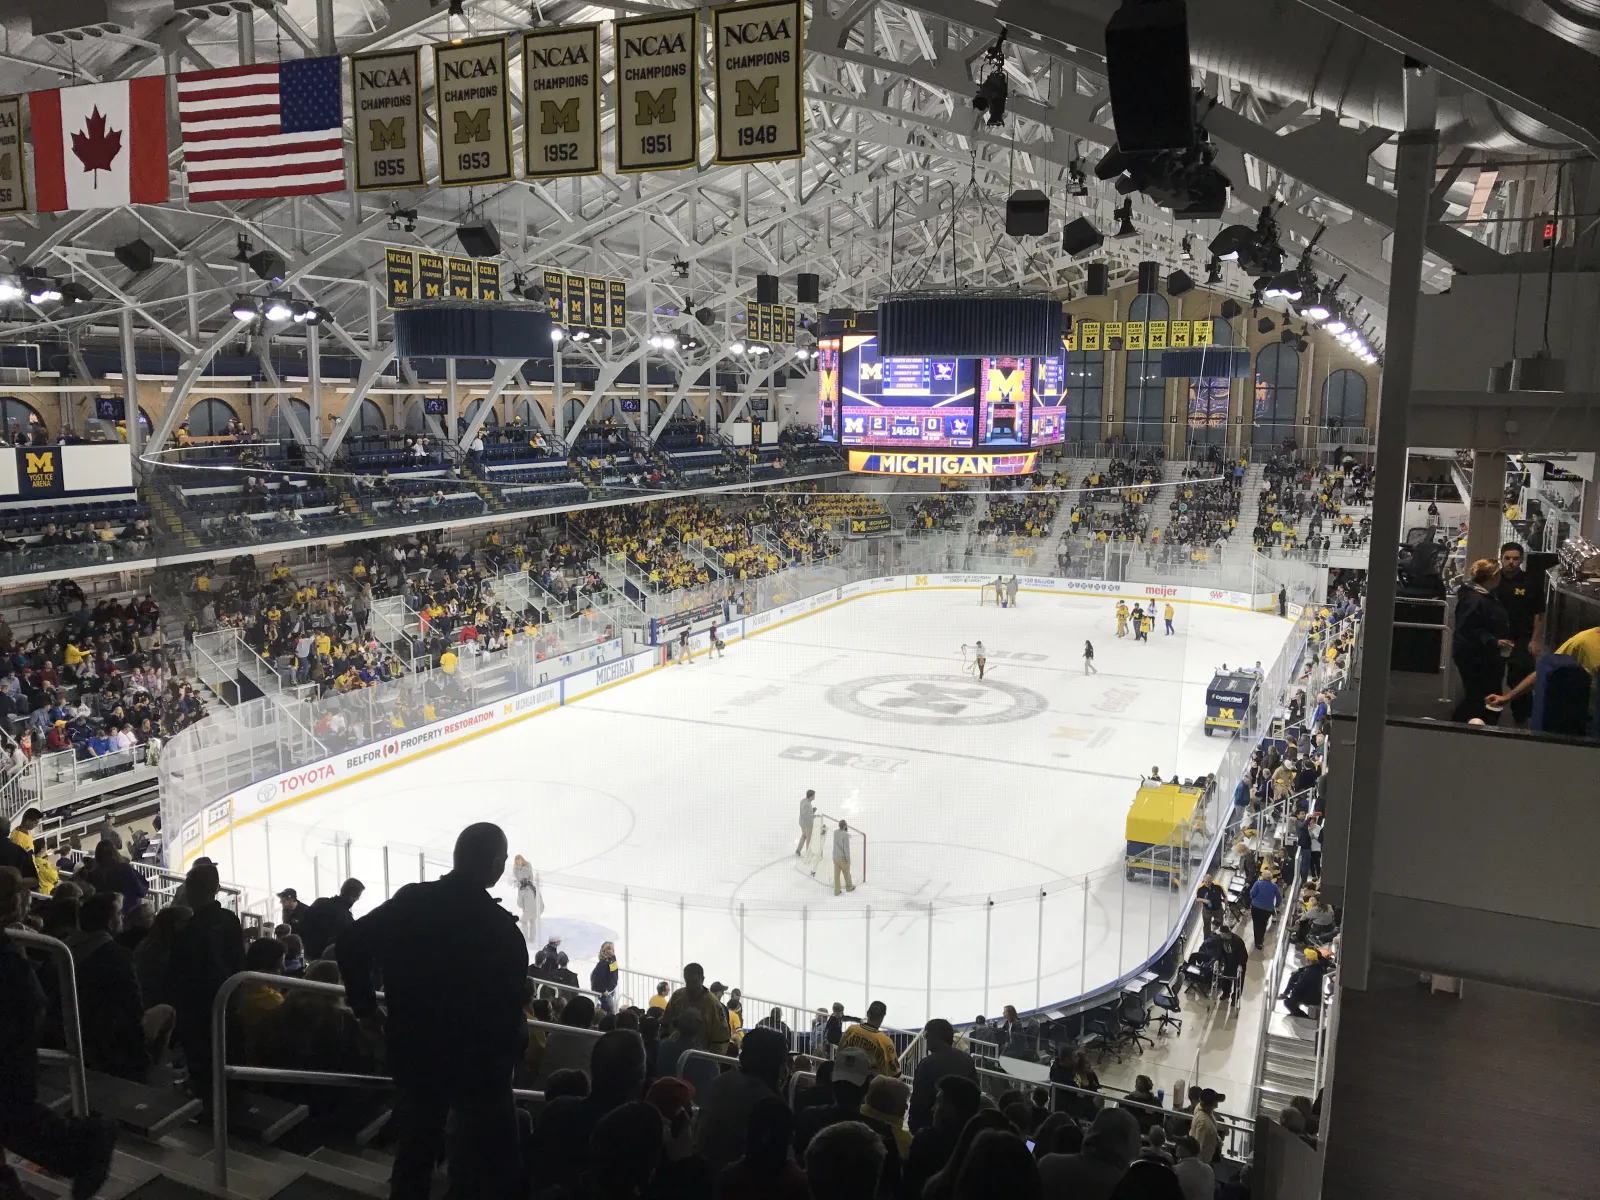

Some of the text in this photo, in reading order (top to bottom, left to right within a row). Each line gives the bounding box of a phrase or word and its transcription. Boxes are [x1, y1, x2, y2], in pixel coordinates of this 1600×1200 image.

[724, 18, 791, 47] NCAA
[624, 33, 686, 59] NCAA
[531, 44, 589, 69] NCAA
[726, 50, 790, 71] CHAMPIONS
[443, 56, 498, 81] NCAA
[625, 63, 686, 81] CHAMPIONS
[359, 67, 411, 90] NCAA
[533, 74, 589, 91] CHAMPIONS
[361, 95, 411, 110] CHAMPIONS
[444, 85, 498, 102] CHAMPIONS
[735, 76, 780, 117] M
[540, 97, 580, 134] M
[635, 87, 676, 126] M
[369, 117, 405, 151] M
[454, 108, 490, 144] M
[738, 124, 777, 147] 1948
[544, 143, 578, 162] 1952
[641, 134, 672, 155] 1951
[374, 158, 405, 177] 1955
[458, 151, 490, 170] 1953
[388, 253, 411, 264] WCHA
[420, 258, 442, 269] WCHA
[451, 262, 471, 273] WCHA
[480, 266, 496, 276] CCHA
[394, 280, 407, 293] M
[426, 283, 439, 296] M
[572, 300, 581, 312] M
[594, 303, 603, 314] M
[614, 304, 622, 315] M
[861, 363, 882, 380] M
[988, 369, 1025, 402] M
[844, 418, 864, 433] M
[874, 418, 882, 428] 2
[928, 419, 937, 429] 0
[26, 452, 53, 473] M
[880, 455, 992, 474] MICHIGAN
[853, 520, 866, 531] M
[915, 576, 927, 585] M
[1145, 585, 1177, 598] meijer
[596, 658, 635, 686] MICHIGAN
[504, 703, 513, 715] M
[515, 695, 536, 711] MICHIGAN
[1219, 707, 1234, 719] M
[346, 710, 494, 769] BELFOR PROPERTY RESTORATION
[280, 764, 335, 794] TOYOTA
